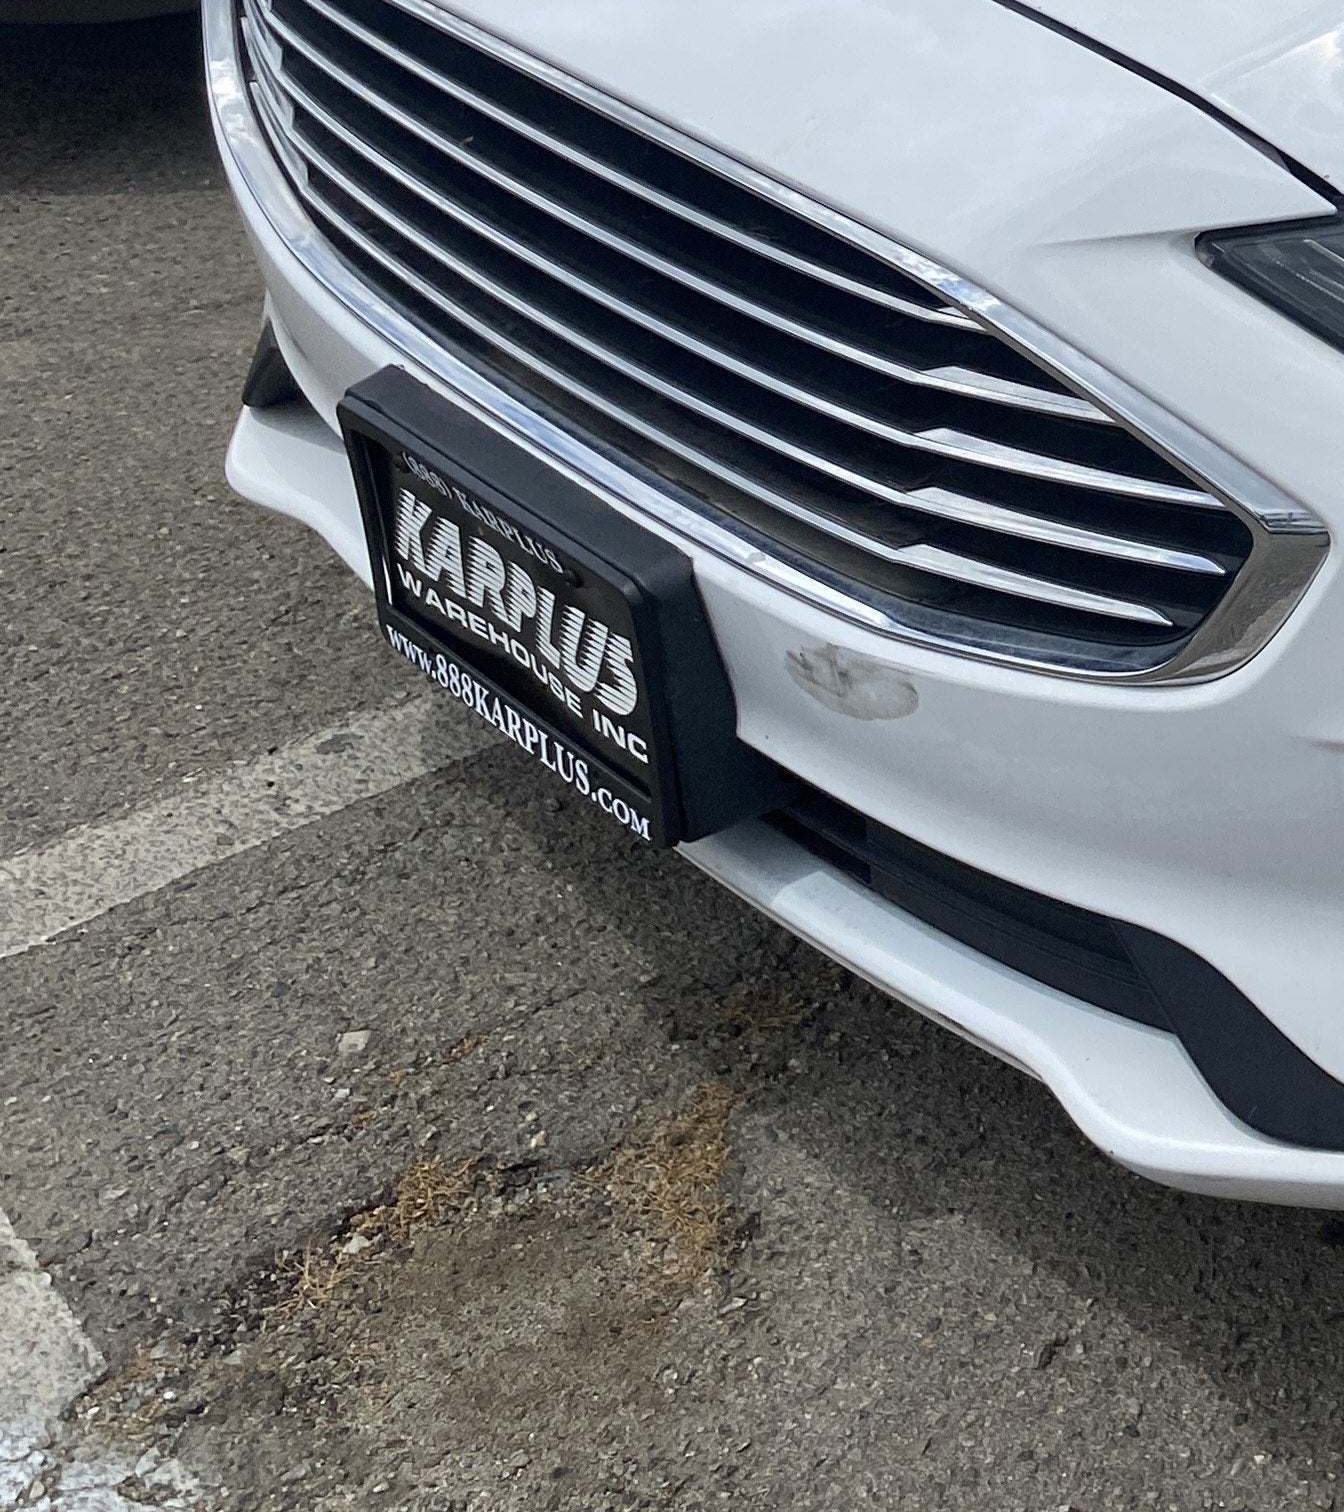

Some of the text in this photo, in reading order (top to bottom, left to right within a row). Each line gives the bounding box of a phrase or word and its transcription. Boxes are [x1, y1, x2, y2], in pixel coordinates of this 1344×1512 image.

[395, 487, 638, 716] KARPLUS
[397, 562, 649, 764] WAREHOUSE INC
